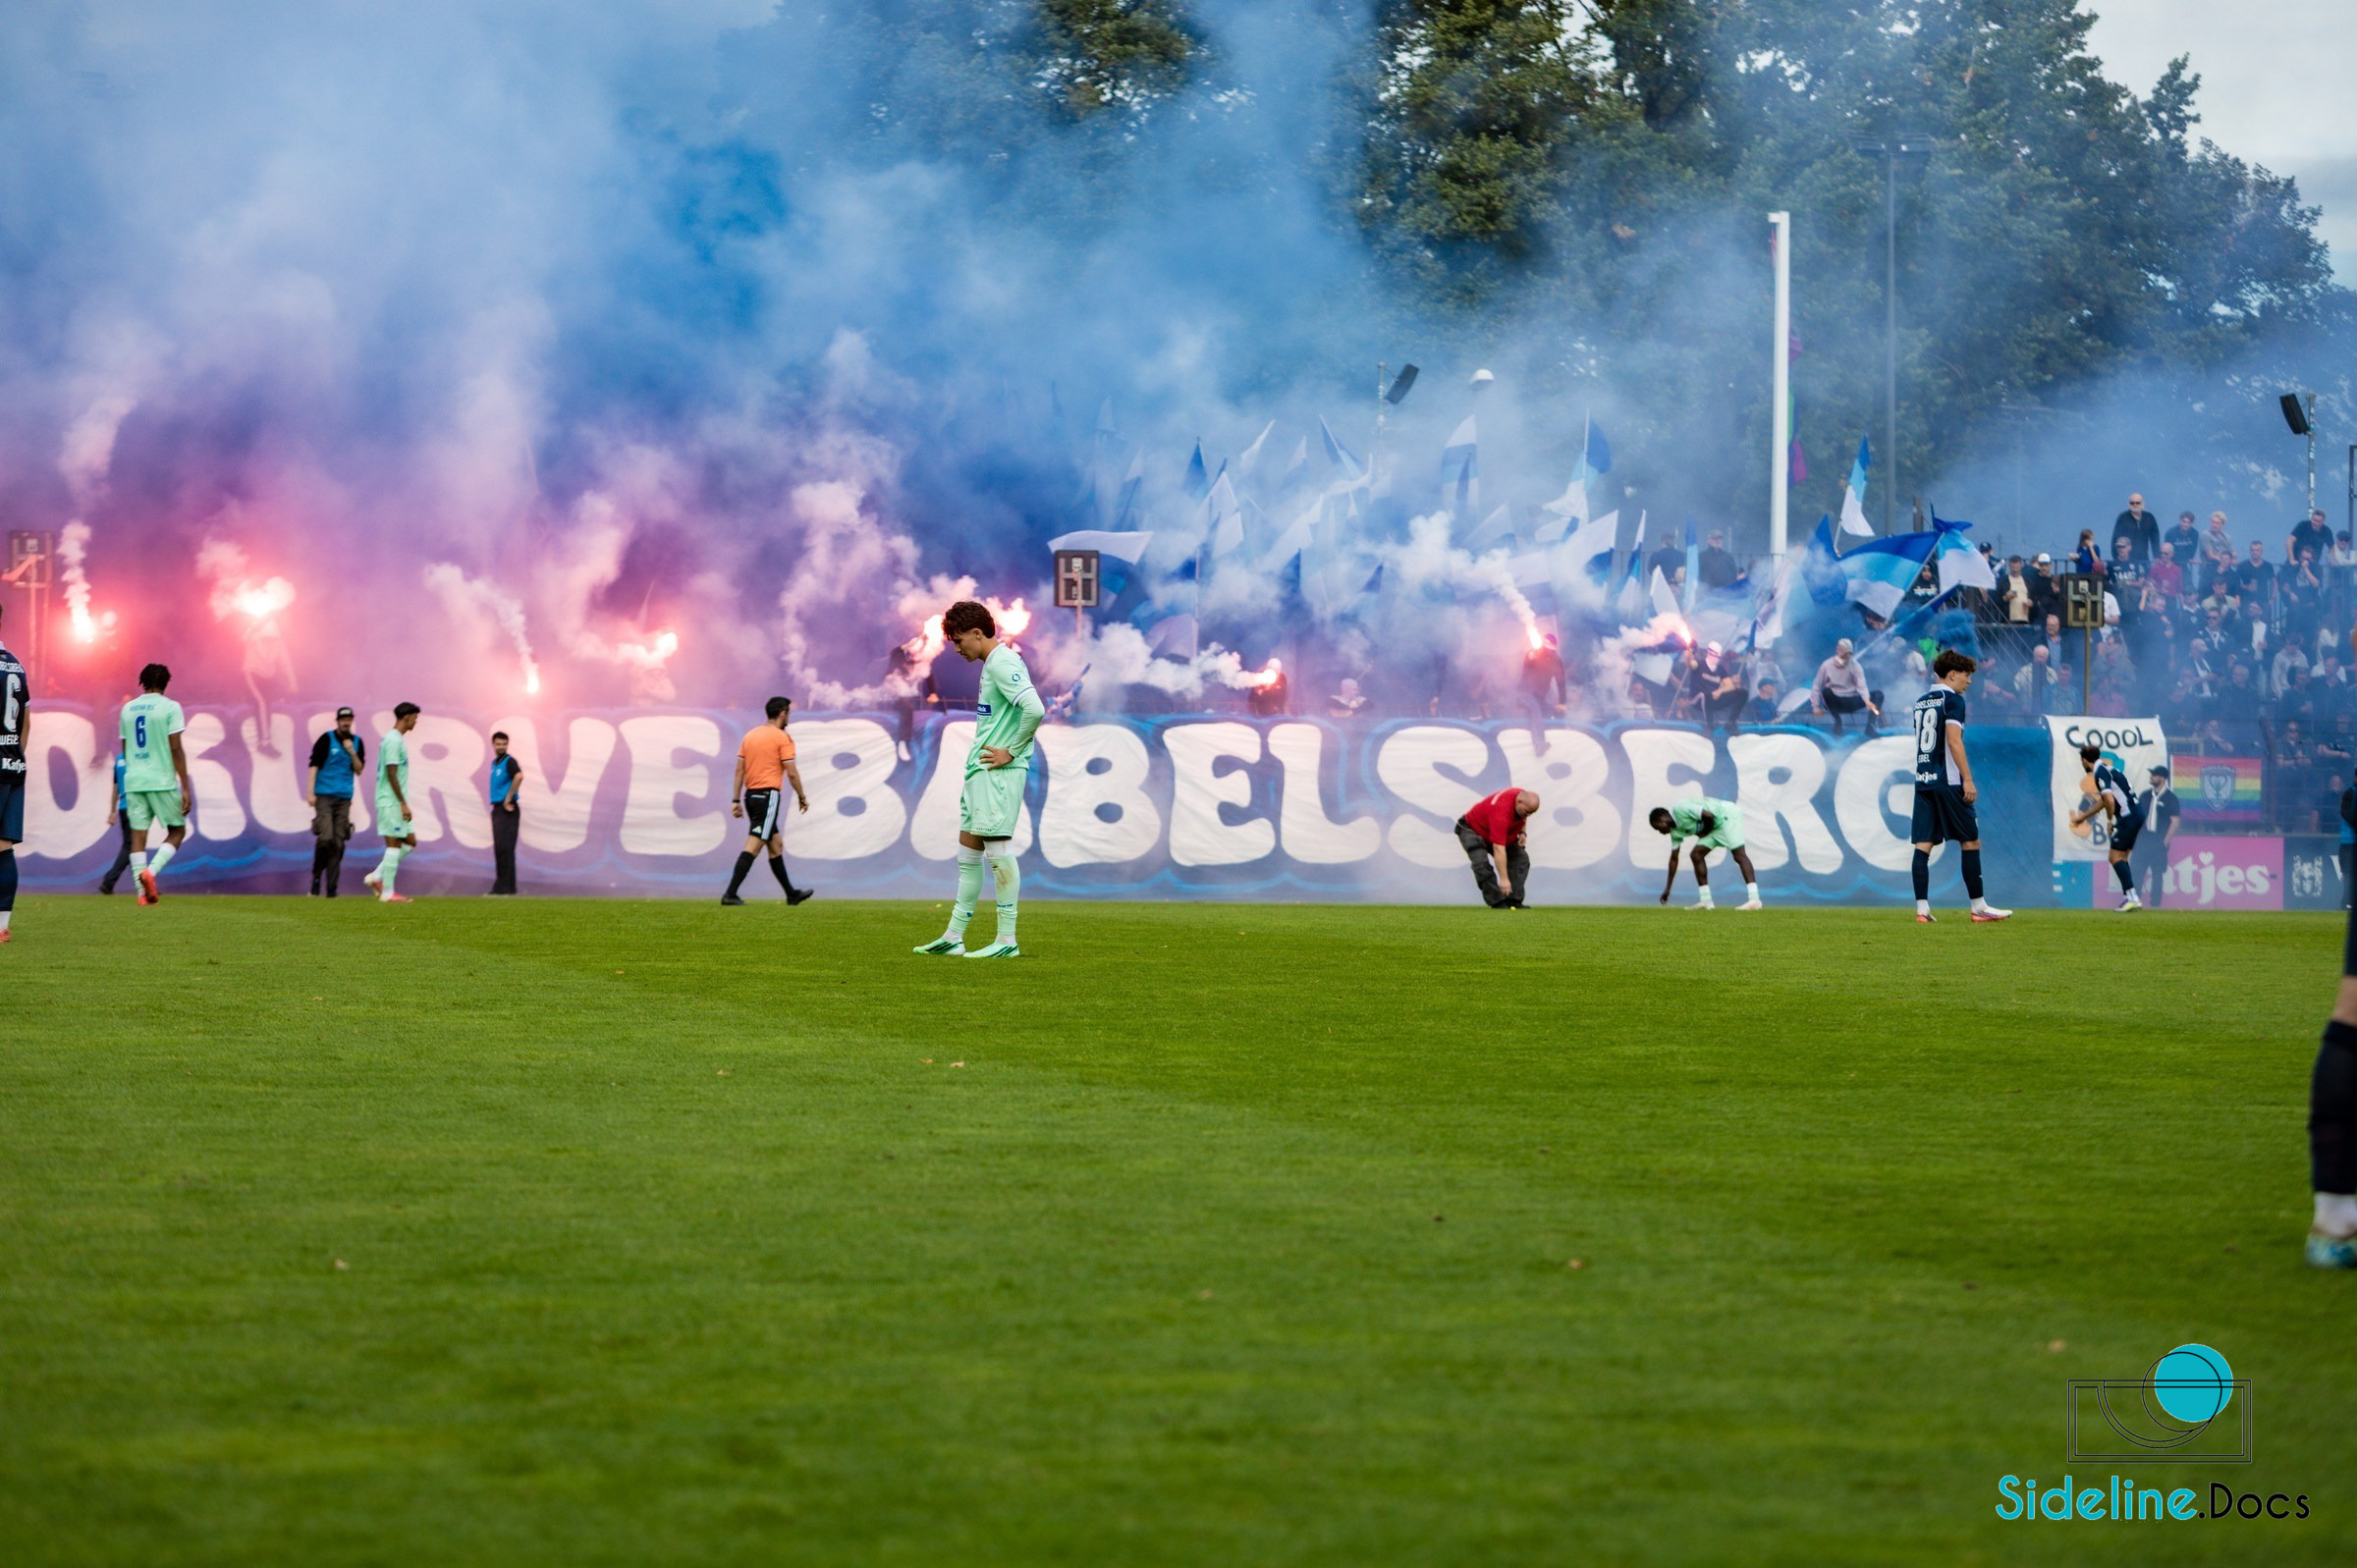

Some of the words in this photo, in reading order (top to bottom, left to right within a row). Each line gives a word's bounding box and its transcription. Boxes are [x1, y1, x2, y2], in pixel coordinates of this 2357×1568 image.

[4, 674, 21, 732] 6
[135, 715, 146, 748] 6
[1915, 708, 1937, 753] 18
[2065, 725, 2154, 749] COOOL
